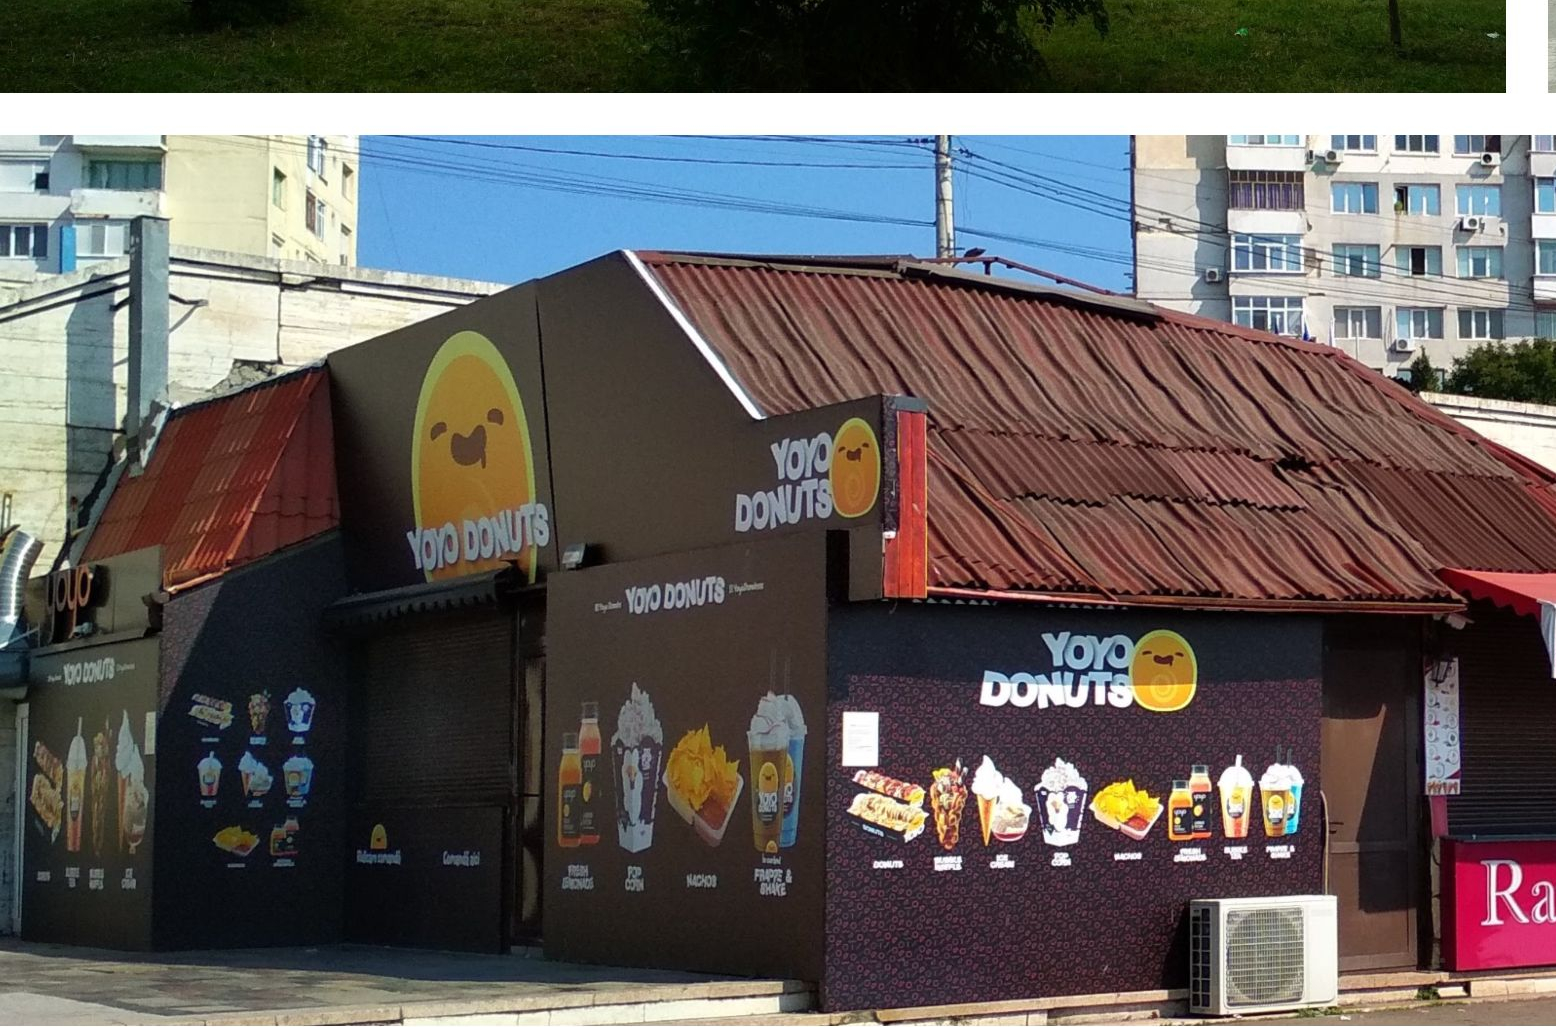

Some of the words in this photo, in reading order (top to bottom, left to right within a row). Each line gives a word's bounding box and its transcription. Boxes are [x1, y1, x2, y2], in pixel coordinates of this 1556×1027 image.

[771, 432, 833, 480] YOYO
[735, 478, 834, 533] DONUTS
[406, 522, 460, 571] YOYO
[463, 503, 550, 561] DONUTS
[625, 584, 662, 615] YOYO
[663, 576, 726, 609] DONUTS
[1041, 631, 1136, 670] YOYO
[979, 669, 1135, 710] DONUTS
[686, 873, 718, 889] NACHOS
[759, 883, 787, 897] SHAKE
